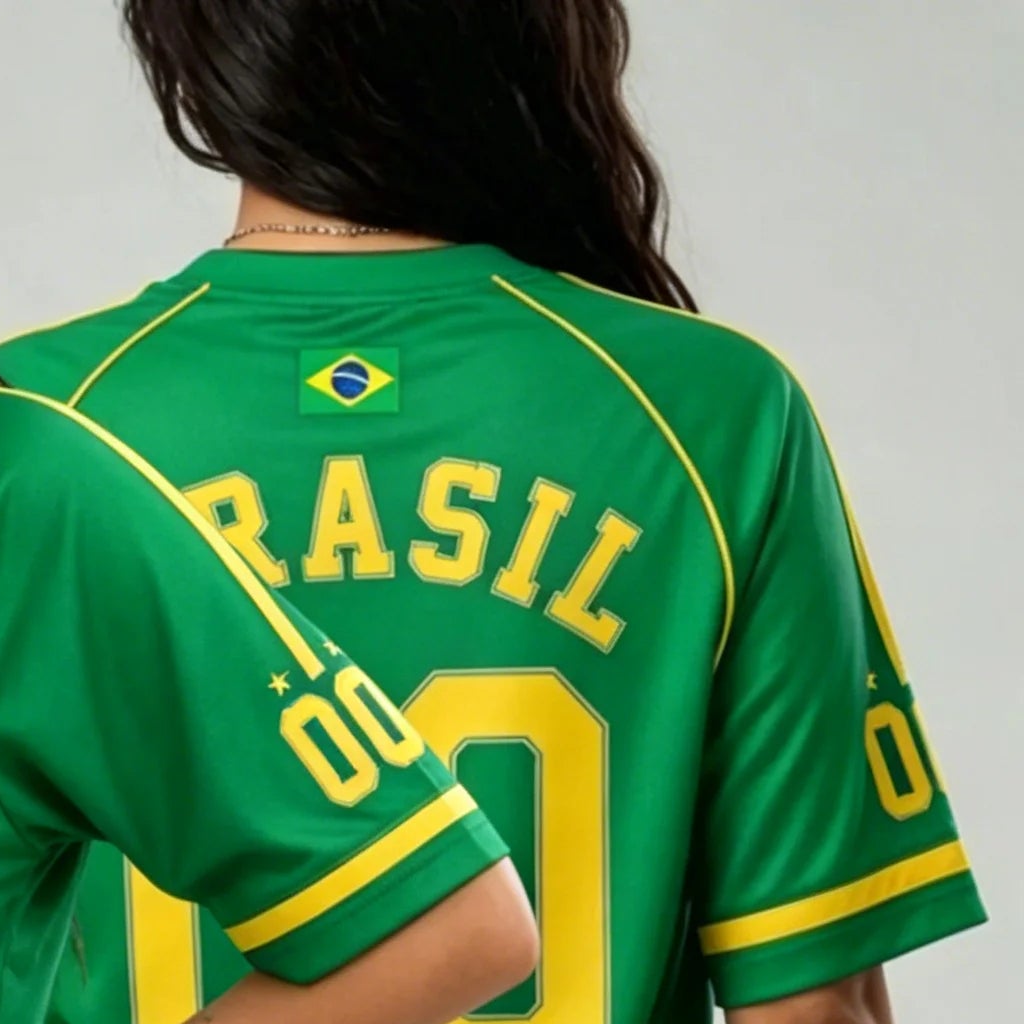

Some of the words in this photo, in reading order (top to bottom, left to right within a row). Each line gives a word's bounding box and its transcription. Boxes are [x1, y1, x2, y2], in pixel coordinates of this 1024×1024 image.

[180, 454, 644, 655] RASIL
[279, 665, 425, 808] 00
[864, 701, 945, 822] 0
